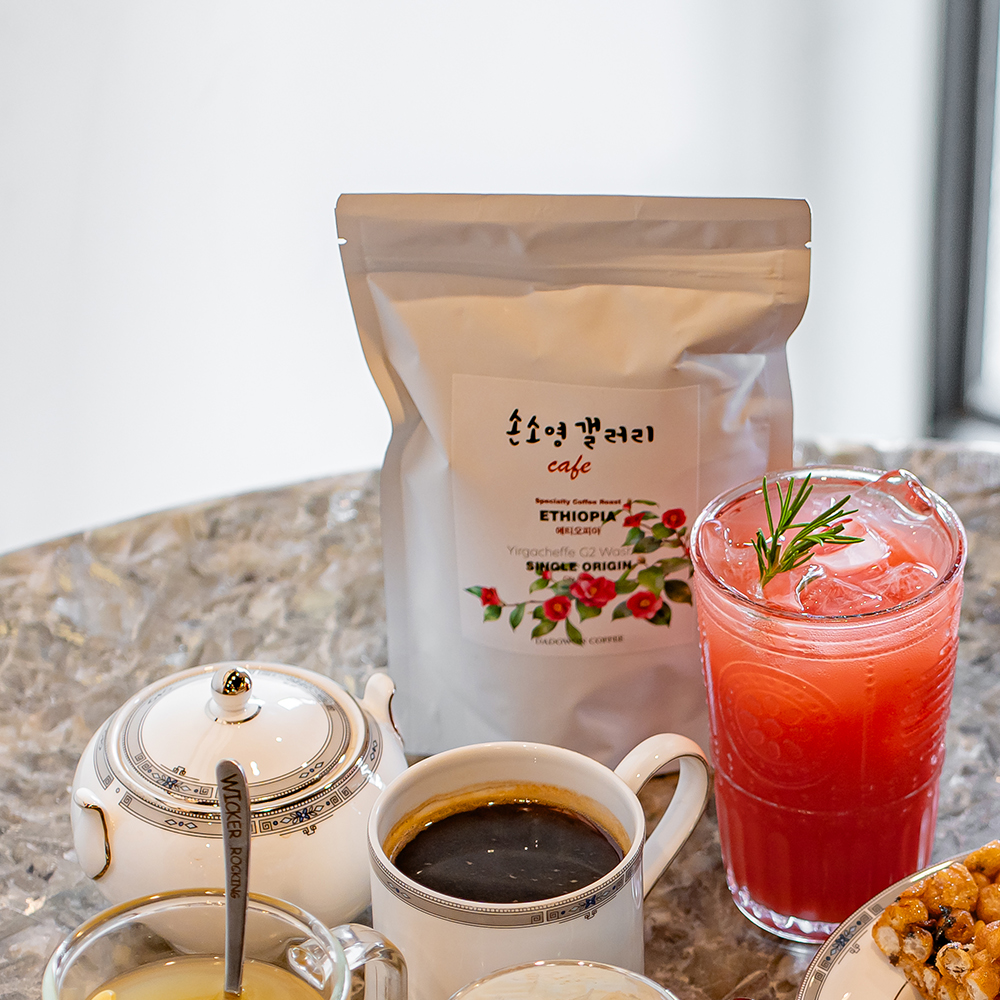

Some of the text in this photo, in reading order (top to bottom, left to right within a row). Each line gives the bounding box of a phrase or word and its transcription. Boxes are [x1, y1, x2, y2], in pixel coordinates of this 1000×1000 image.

[506, 408, 655, 450] 손소영 갤러리
[547, 454, 592, 481] cafe
[535, 497, 571, 506] Specialty
[539, 509, 617, 522] ETHIOPIA
[555, 526, 601, 536] 에티오피아
[507, 545, 576, 559] Yirgacheffe
[526, 560, 632, 572] SINGLE ORIGIN
[588, 634, 624, 645] COFFEE
[220, 773, 242, 899] WICKER ROCKING
